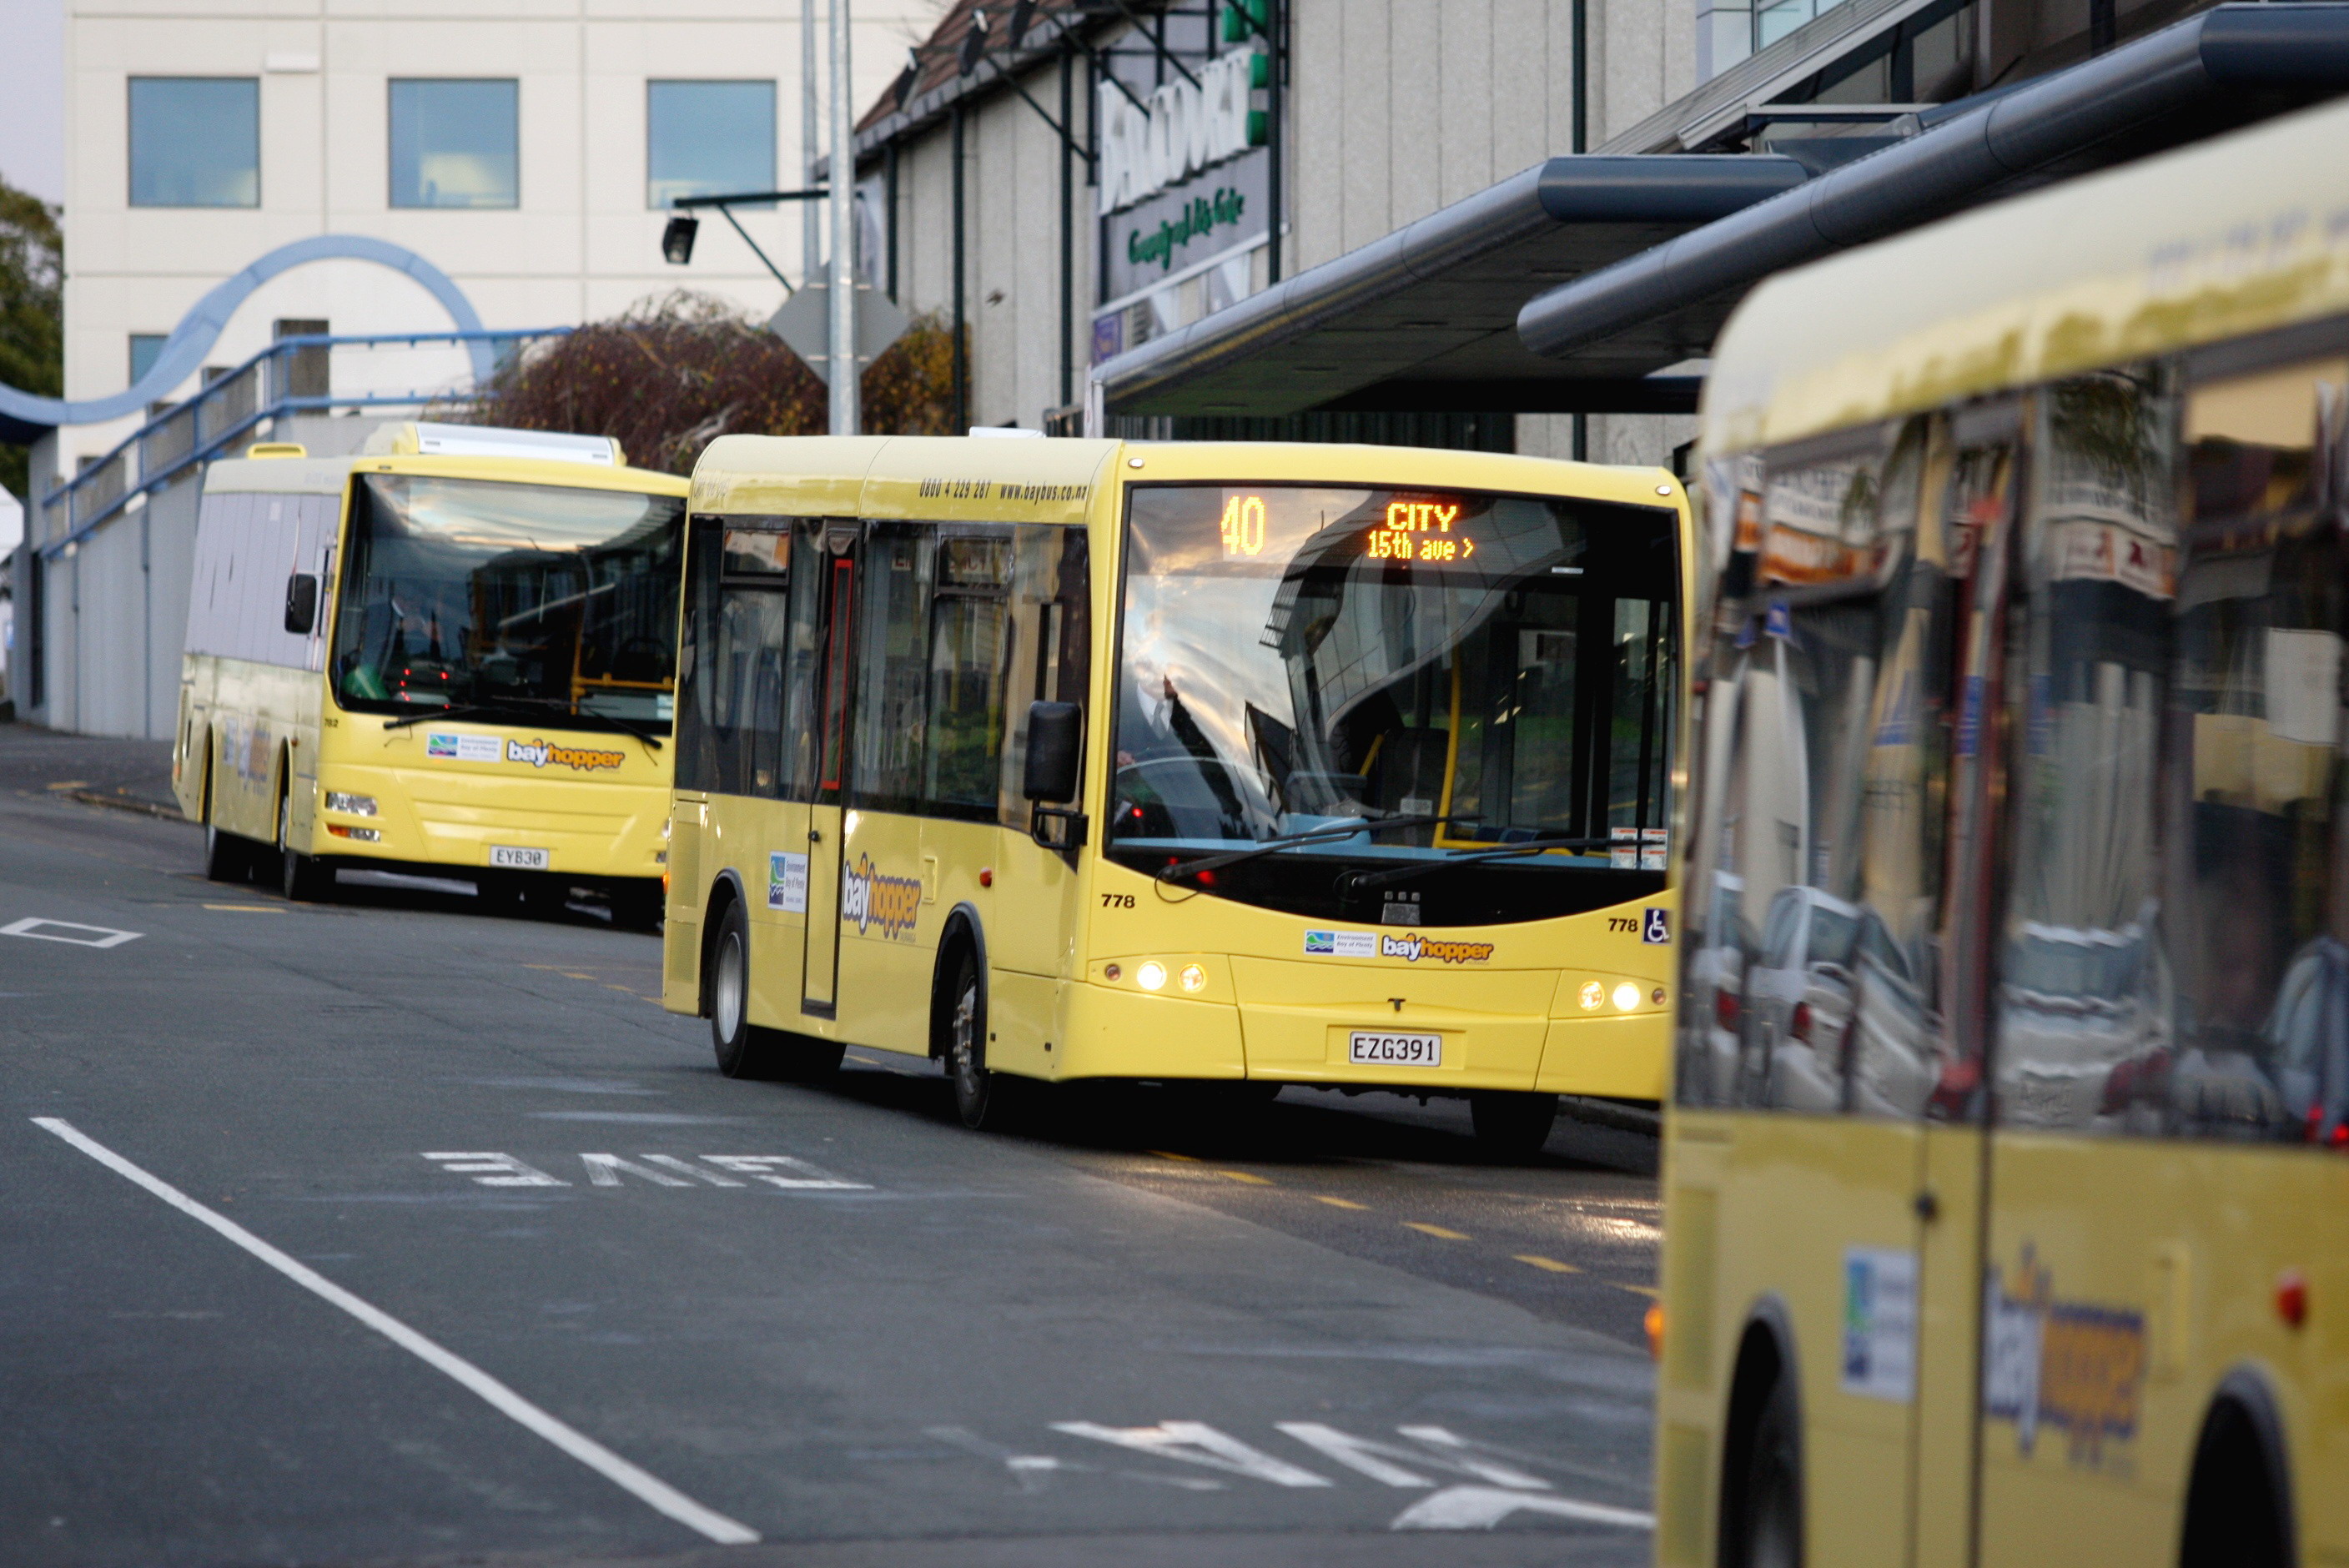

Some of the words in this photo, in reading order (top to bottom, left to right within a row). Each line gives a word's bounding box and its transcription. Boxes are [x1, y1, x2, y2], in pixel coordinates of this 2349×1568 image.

[919, 478, 943, 498] 0800
[944, 479, 952, 498] 4
[953, 479, 971, 499] 229
[973, 479, 992, 500] 287
[1000, 480, 1089, 505] www.baybus.co.nz
[1220, 495, 1265, 556] 40
[1386, 502, 1458, 533] CITY
[1368, 530, 1412, 560] 15th
[1420, 540, 1456, 561] ave
[507, 738, 625, 771] bayhopper
[496, 849, 541, 866] EYB30
[843, 852, 921, 940] bayhopper
[1101, 893, 1135, 908] 778
[1608, 918, 1638, 932] 778
[1381, 932, 1494, 963] bayhopper
[1353, 1037, 1434, 1062] EZG391
